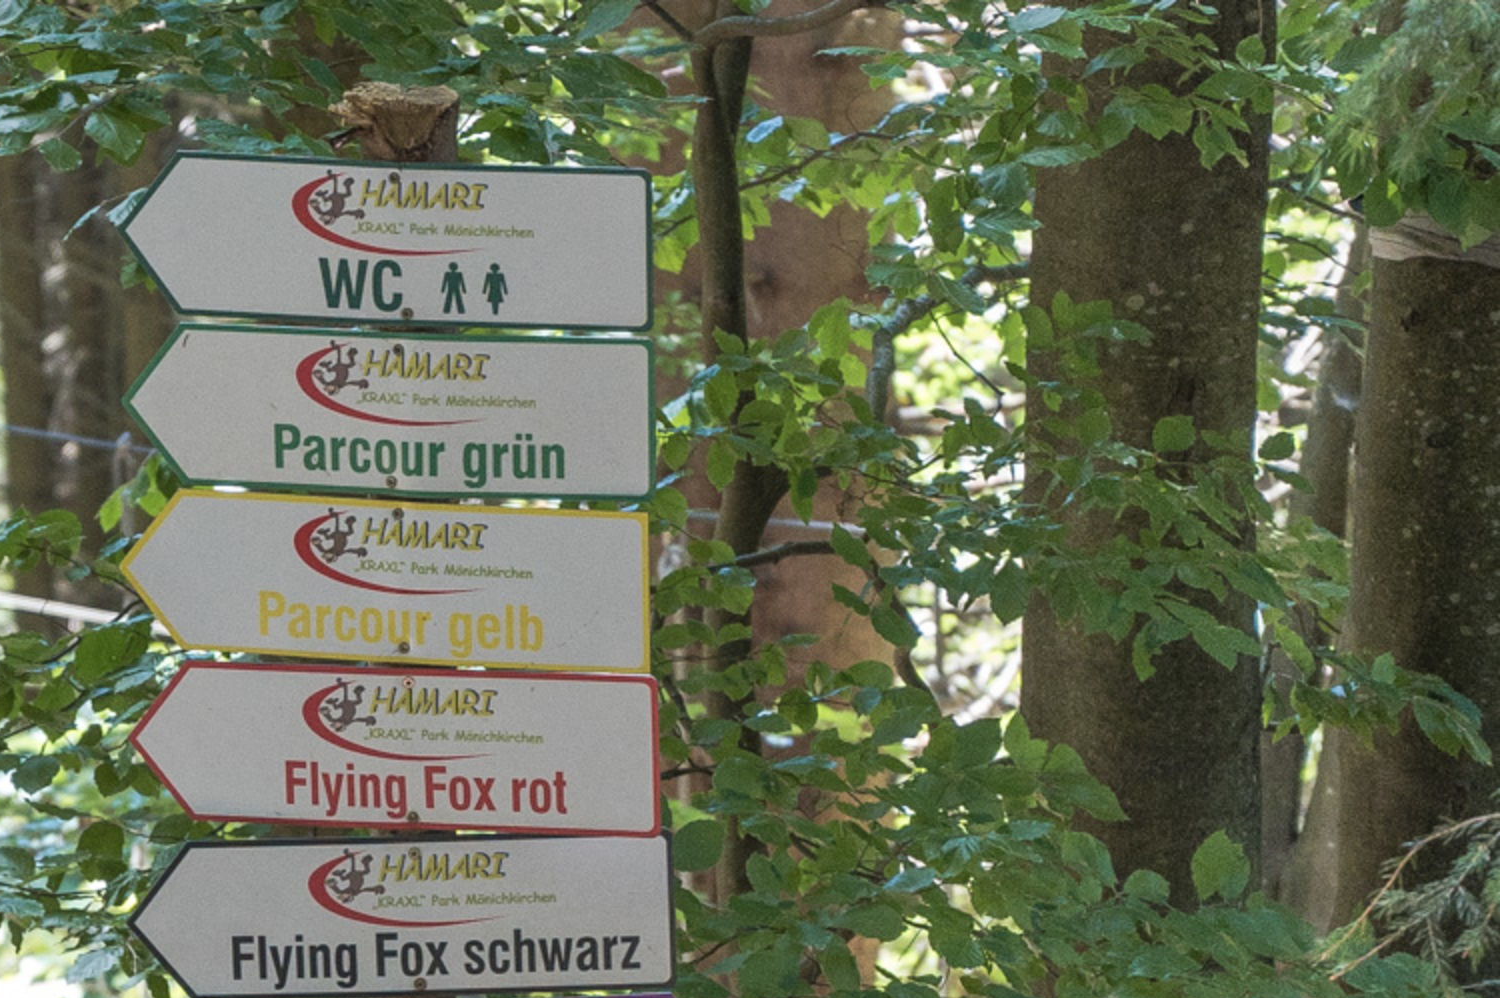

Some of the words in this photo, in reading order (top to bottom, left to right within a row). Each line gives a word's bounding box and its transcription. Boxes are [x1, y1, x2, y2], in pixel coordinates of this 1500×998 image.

[360, 179, 488, 211] HAMARI
[410, 223, 438, 235] Park
[318, 257, 402, 312] WC
[363, 349, 490, 382] HAMARI
[412, 393, 440, 406] Park
[273, 423, 445, 478] Parcour
[463, 433, 565, 489] grün
[361, 517, 488, 551] HAMARI
[411, 562, 439, 575] Park
[258, 591, 431, 647] Parcour
[449, 605, 543, 658] gelb
[370, 686, 498, 717] HAMARI
[421, 730, 449, 741] Park
[285, 760, 408, 819] Flying
[424, 766, 497, 814] Fox
[512, 772, 568, 815] rot
[379, 852, 509, 882] HAMARI
[431, 894, 460, 906] Park
[232, 935, 357, 990] Flying
[376, 932, 448, 978] Fox
[464, 929, 641, 976] schwarz
